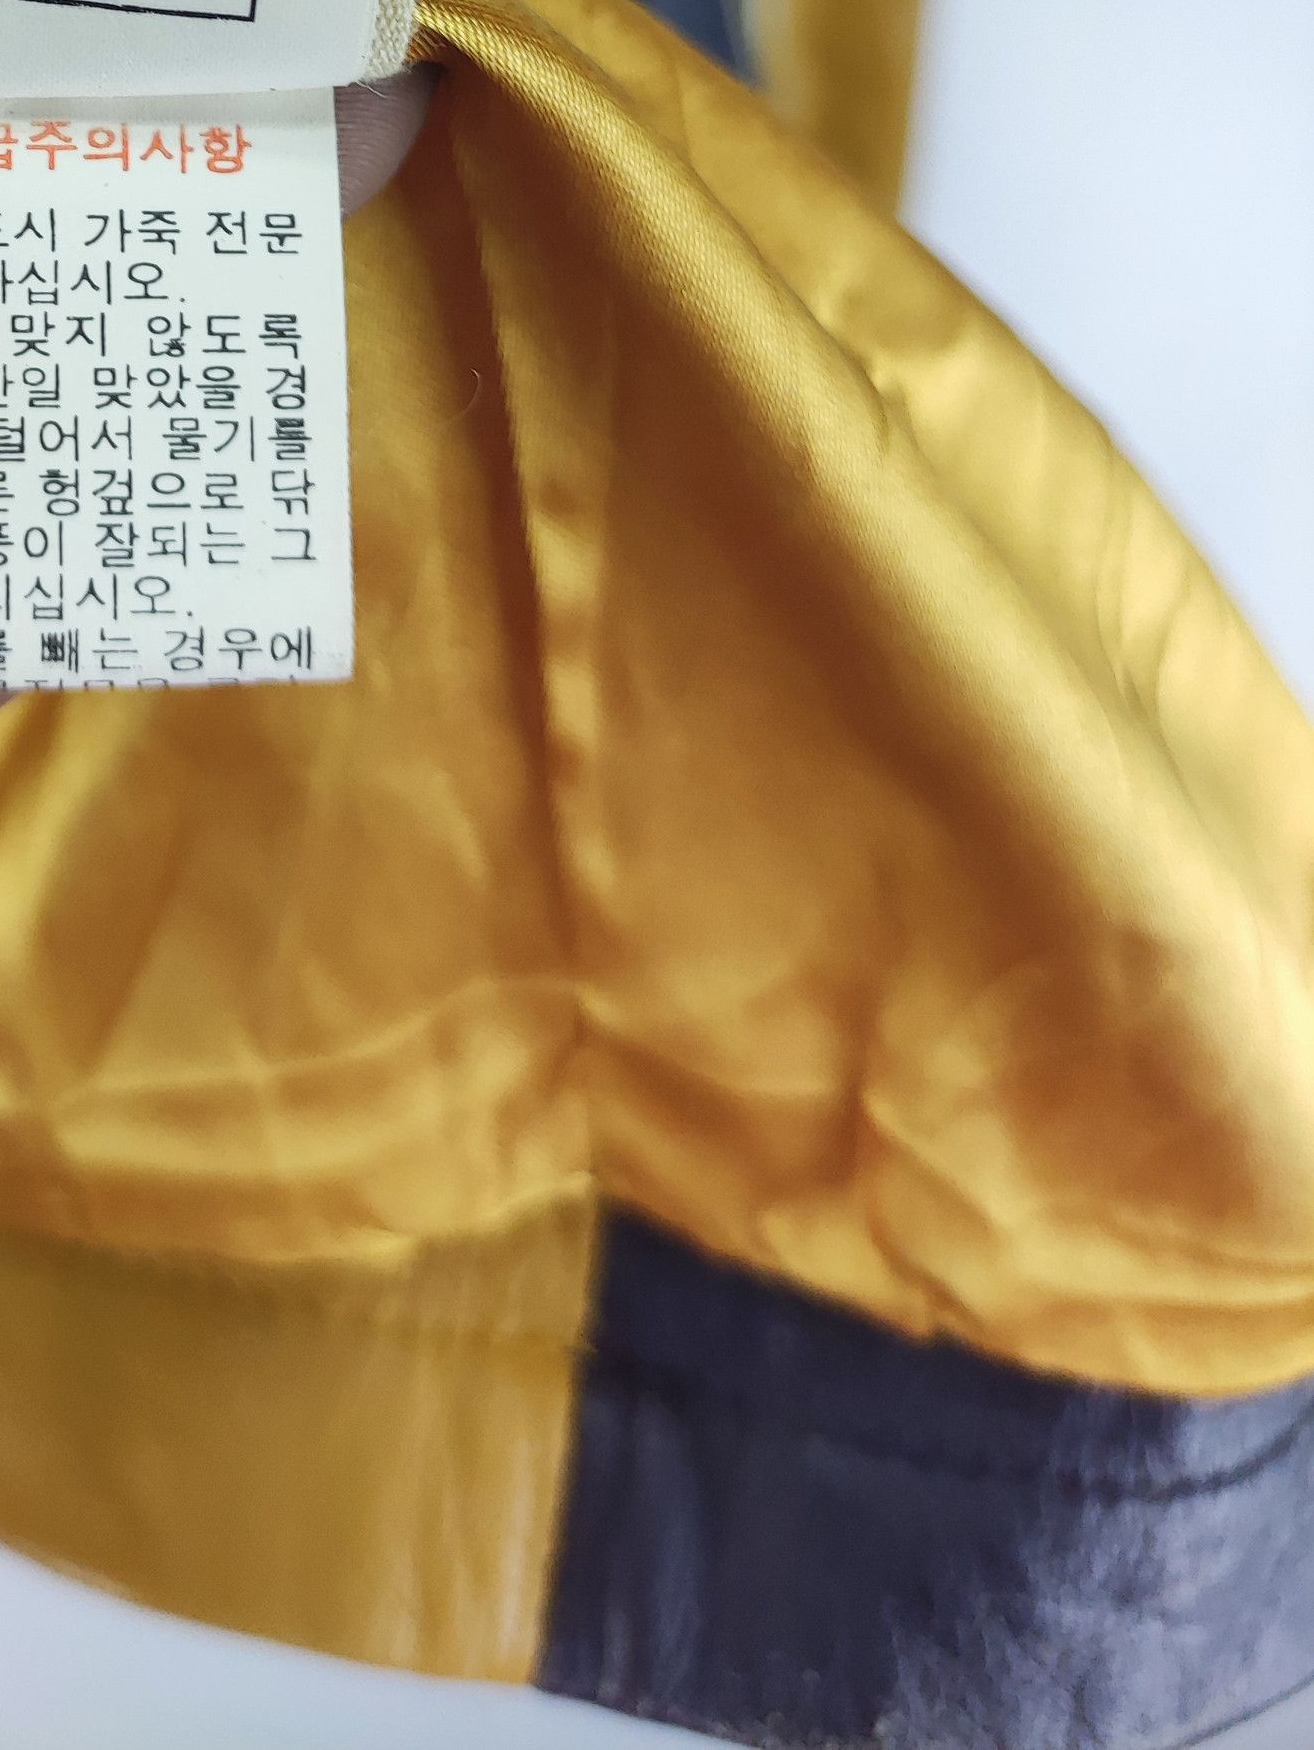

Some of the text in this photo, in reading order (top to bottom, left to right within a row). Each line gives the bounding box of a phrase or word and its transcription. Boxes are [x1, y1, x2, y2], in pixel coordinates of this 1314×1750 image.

[83, 208, 182, 256] 가죽
[205, 209, 303, 255] 전문
[10, 310, 107, 358] 맞지
[146, 311, 303, 360] 않도록
[92, 363, 242, 410] 맞았을
[265, 364, 307, 411] 경
[161, 415, 313, 463] 물기를
[38, 468, 245, 517] 헝겊으로
[270, 468, 316, 516] 닦
[94, 520, 246, 569] 잘되는
[270, 527, 318, 561] 그
[40, 627, 139, 674] 빼는
[164, 625, 313, 672] 경우에
